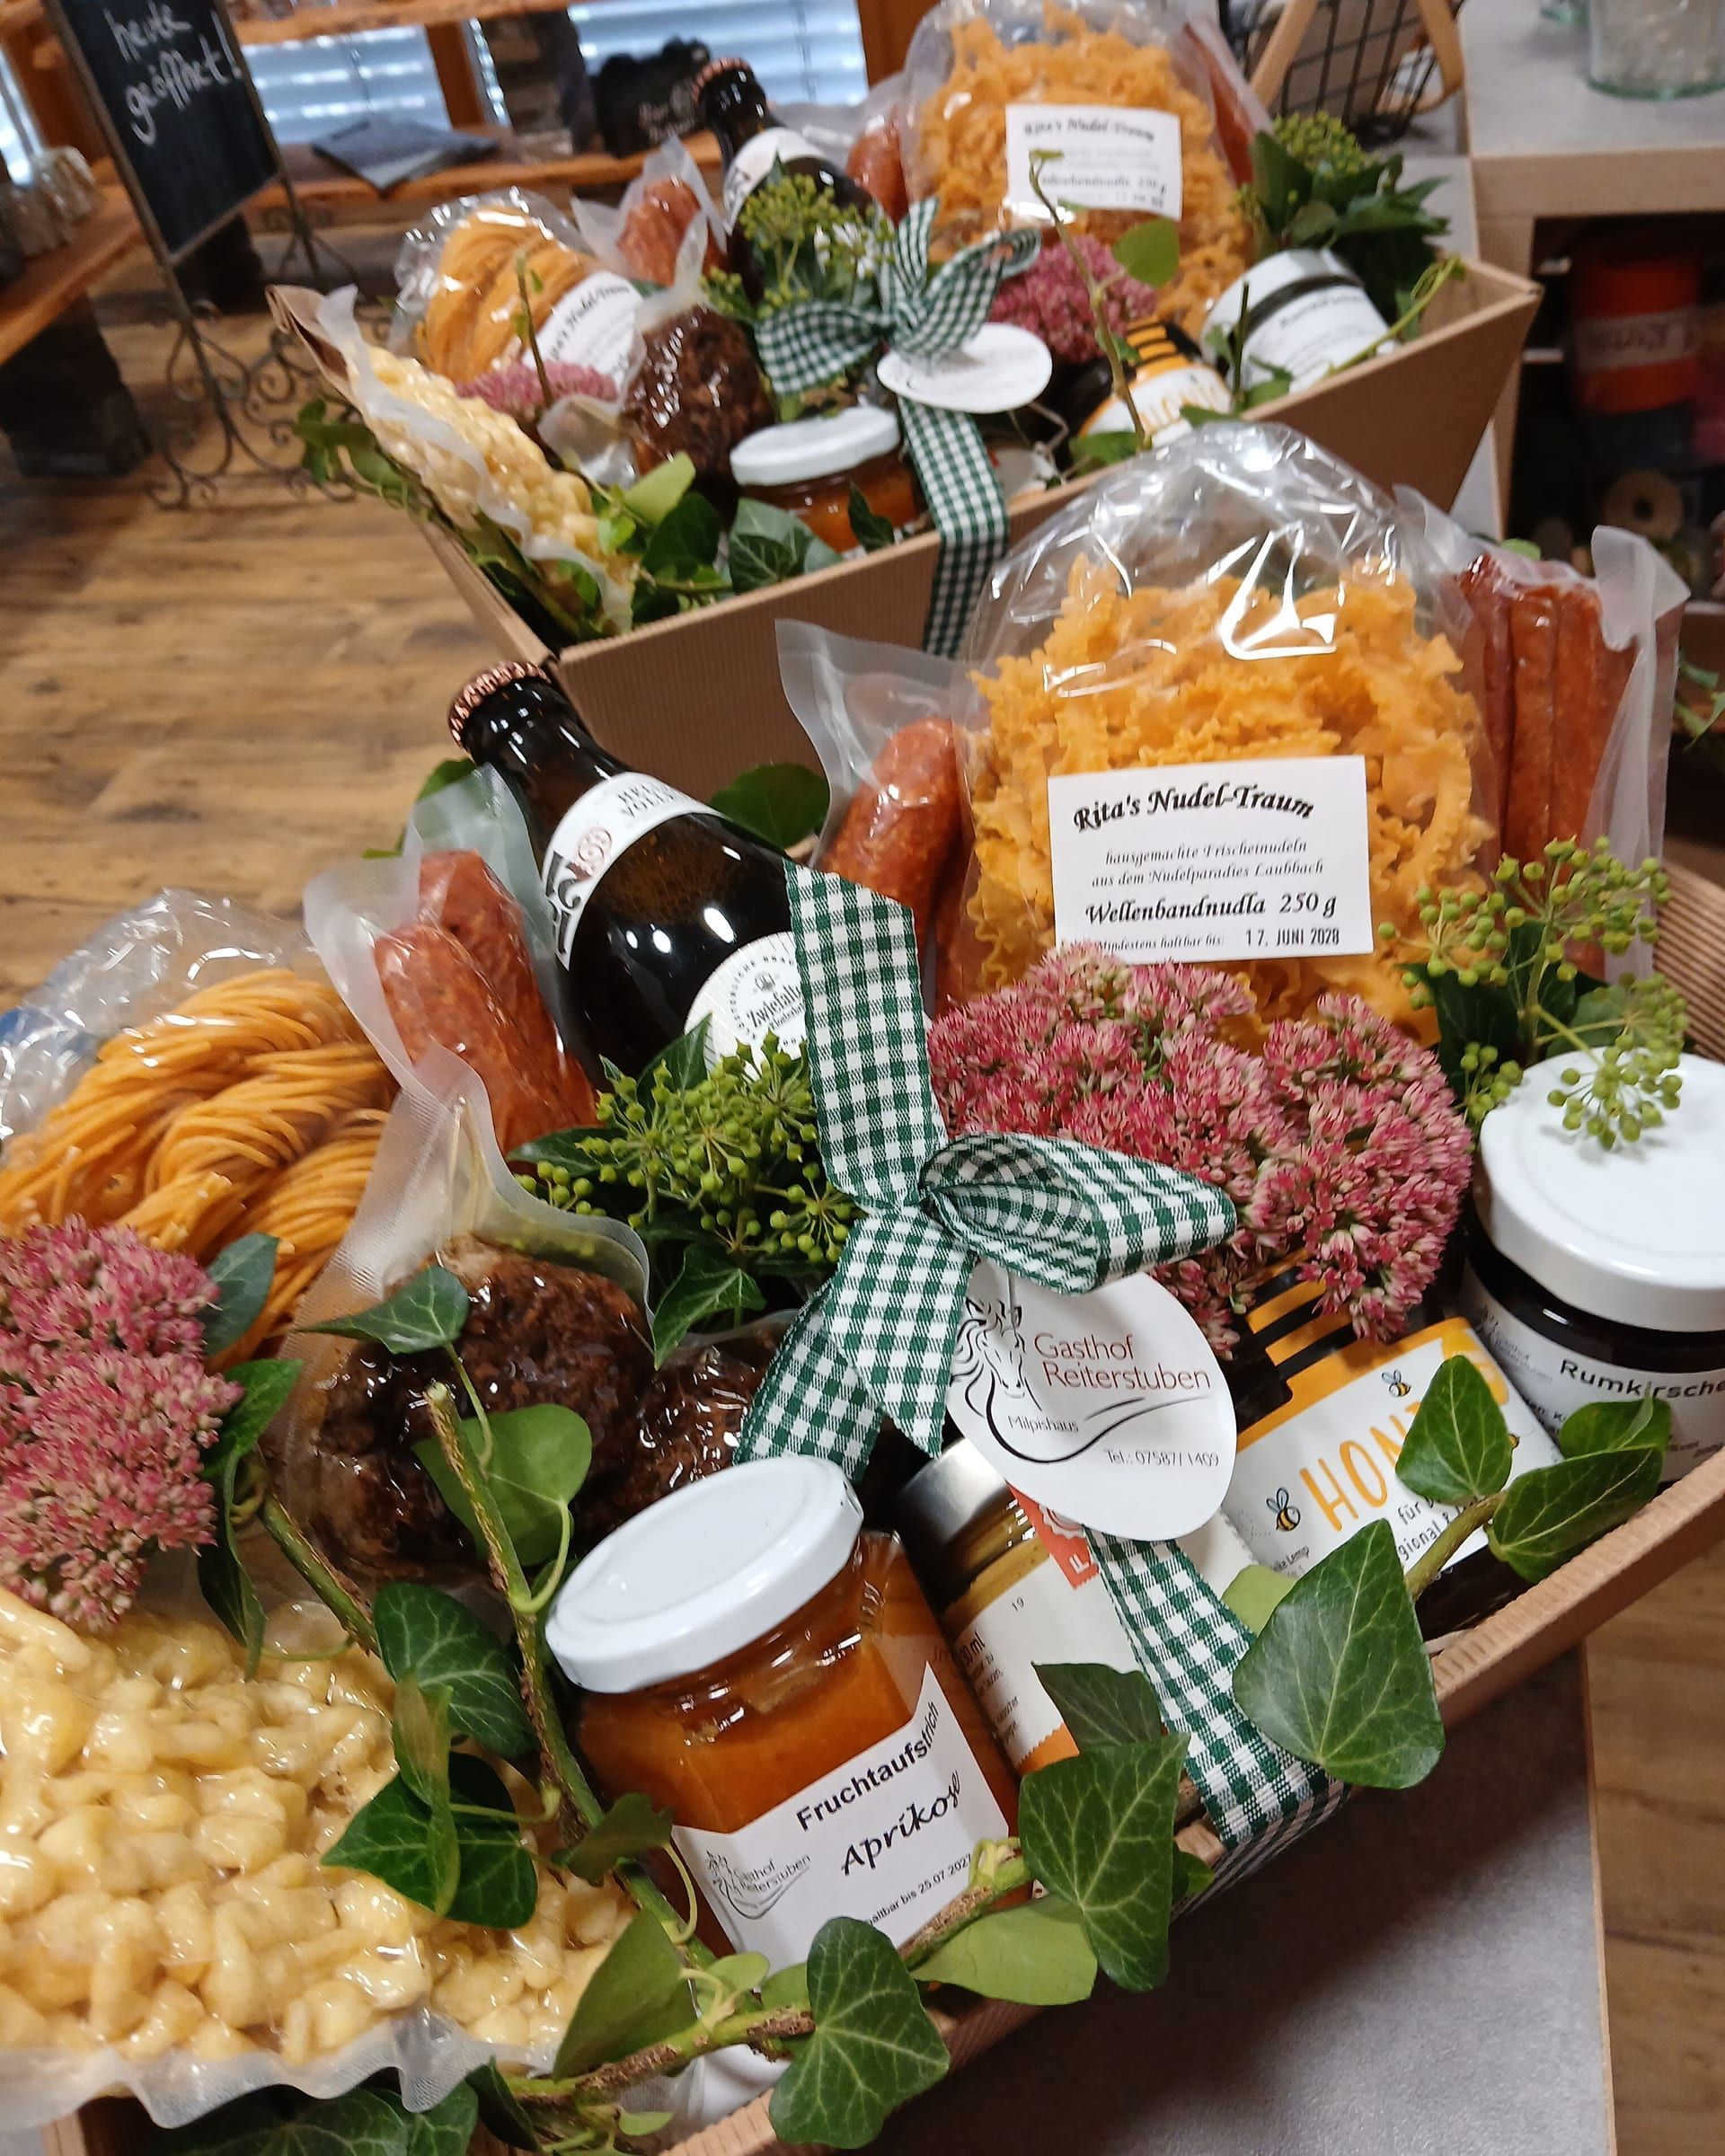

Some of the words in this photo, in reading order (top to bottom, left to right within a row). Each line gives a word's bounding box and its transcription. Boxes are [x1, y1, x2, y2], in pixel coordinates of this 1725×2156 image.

[103, 0, 193, 65] heute
[1073, 794, 1141, 833] Rita's
[1146, 781, 1314, 819] Nudel-Traum
[1105, 842, 1199, 868] hausgemachte
[1092, 872, 1114, 888] aus
[1118, 869, 1145, 886] dem
[1148, 863, 1249, 885] Nudelparadies
[1253, 856, 1323, 878] Laubbach
[1085, 892, 1266, 925] Wellenbandnudla
[1279, 891, 1320, 914] 250
[1322, 894, 1337, 918] g
[1160, 934, 1201, 949] haltbar
[1276, 927, 1305, 948] JUNI
[746, 985, 804, 1029] Zwiefalt
[1034, 1331, 1134, 1361] Gasthof
[1042, 1362, 1211, 1391] Reiterstuben
[1560, 1358, 1725, 1400] Rumkrsche
[1008, 1415, 1079, 1434] Milpishaus
[1299, 1400, 1424, 1532] HON
[1398, 1501, 1421, 1524] für
[1398, 1520, 1441, 1561] gional
[796, 1701, 940, 1832] Fruchtaufstrich
[900, 1890, 916, 1904] bis
